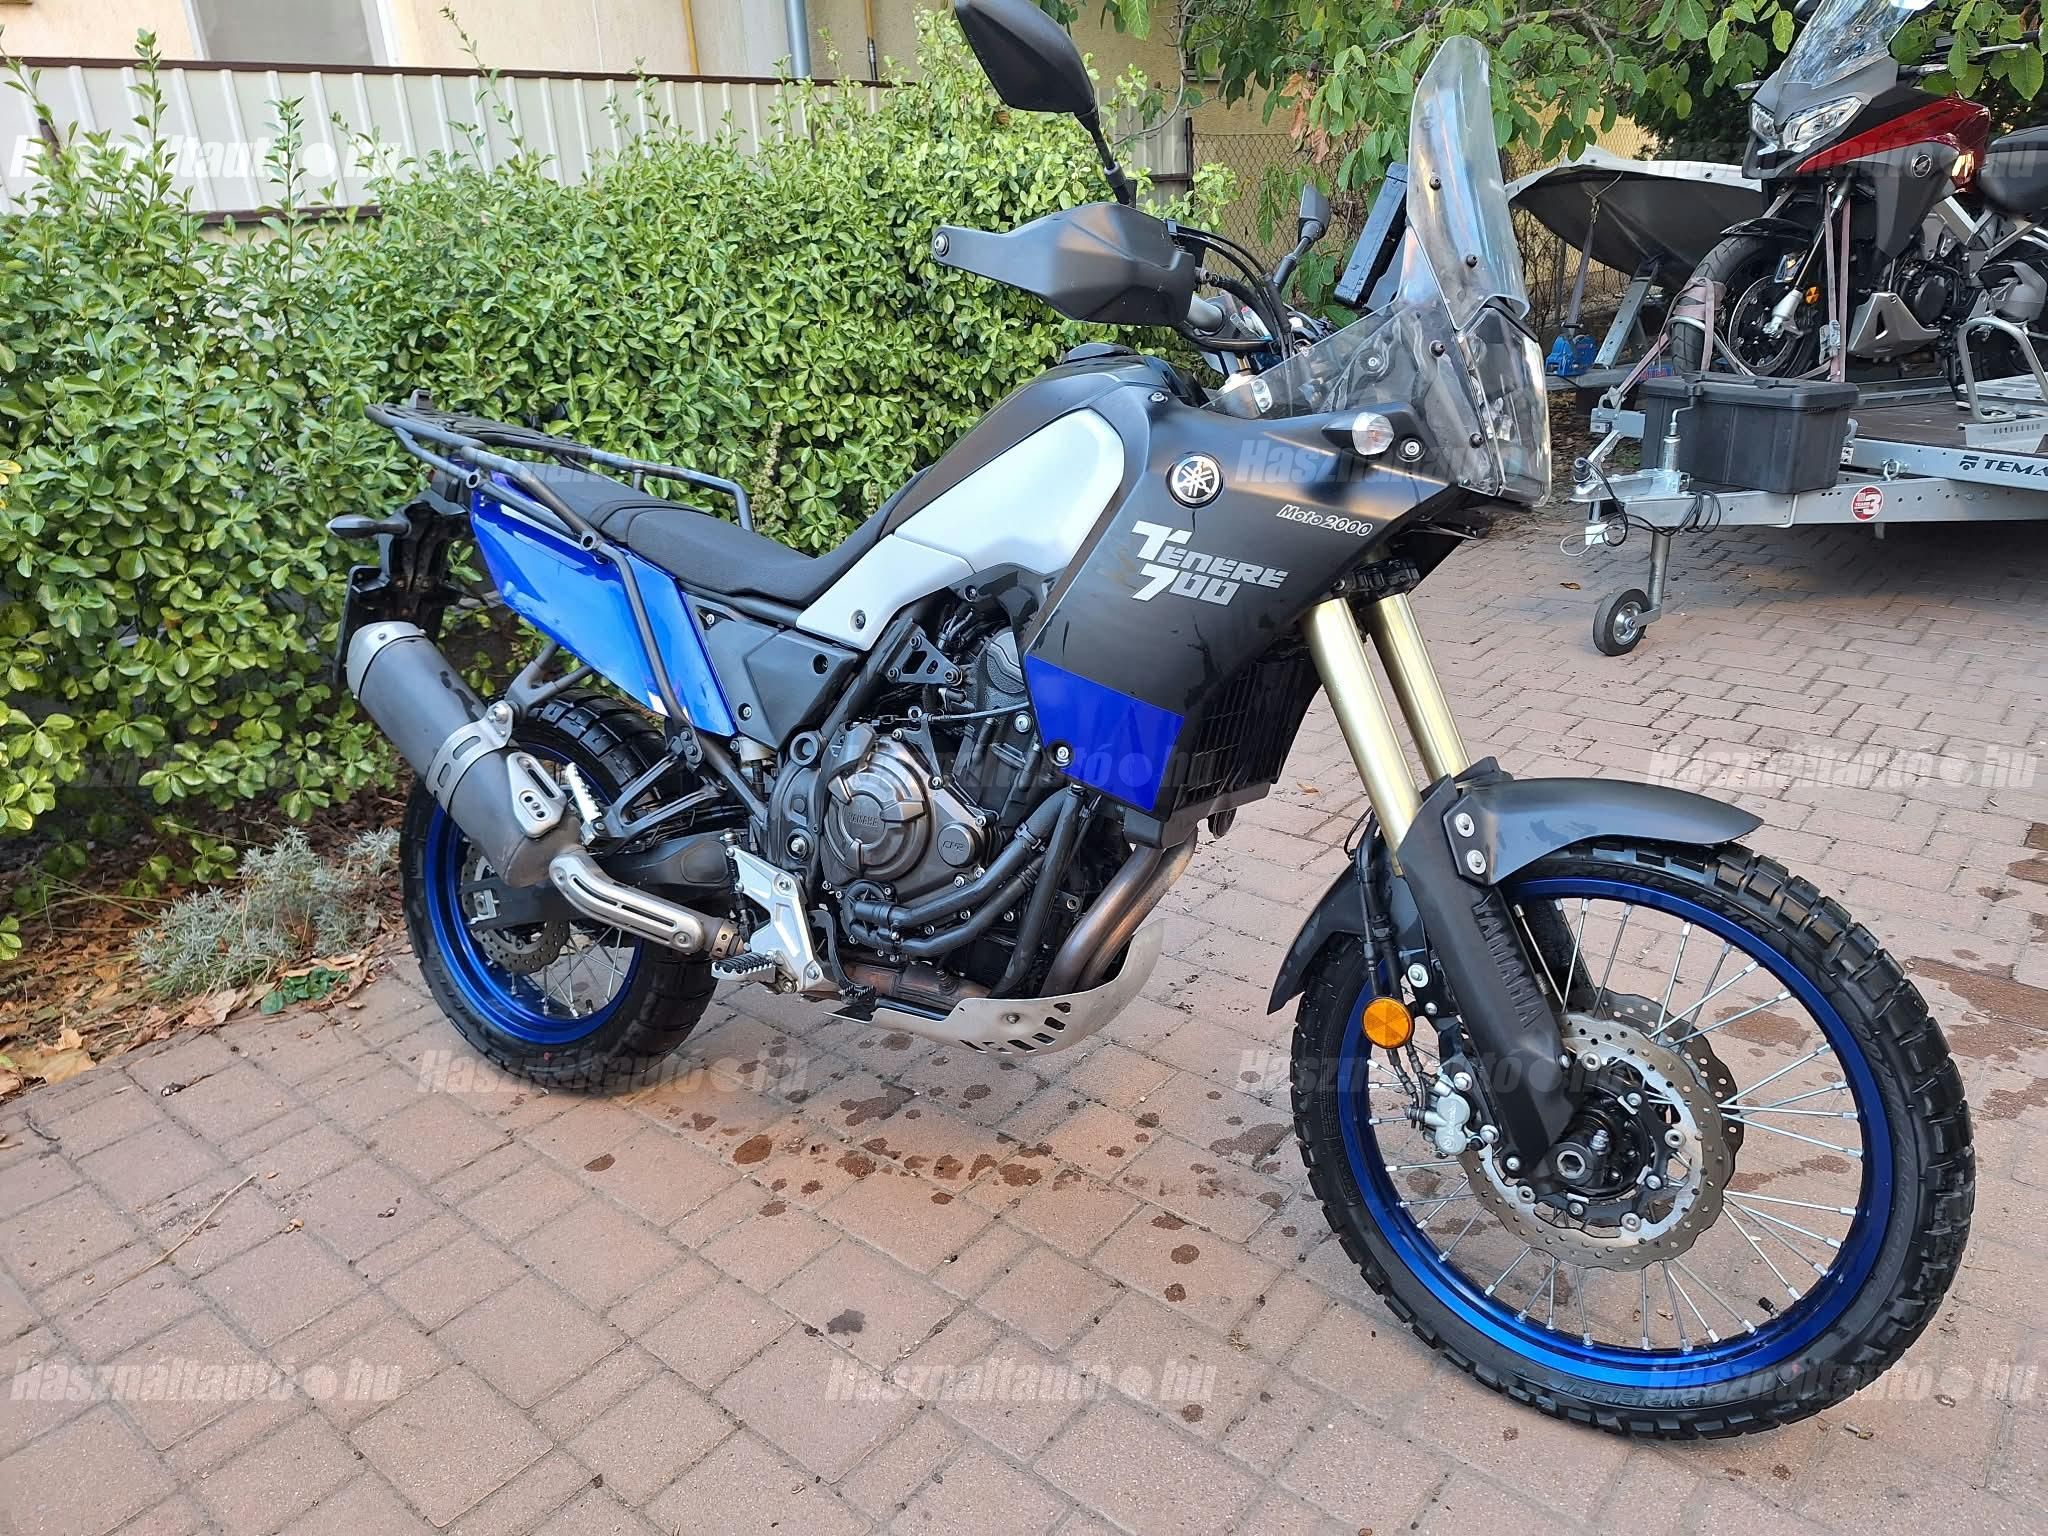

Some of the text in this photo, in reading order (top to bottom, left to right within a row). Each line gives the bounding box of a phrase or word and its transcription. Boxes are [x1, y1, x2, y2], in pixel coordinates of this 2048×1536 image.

[1276, 504, 1373, 536] Moto 2000
[1131, 563, 1241, 606] 700
[1471, 891, 1545, 1029] YAMAHA
